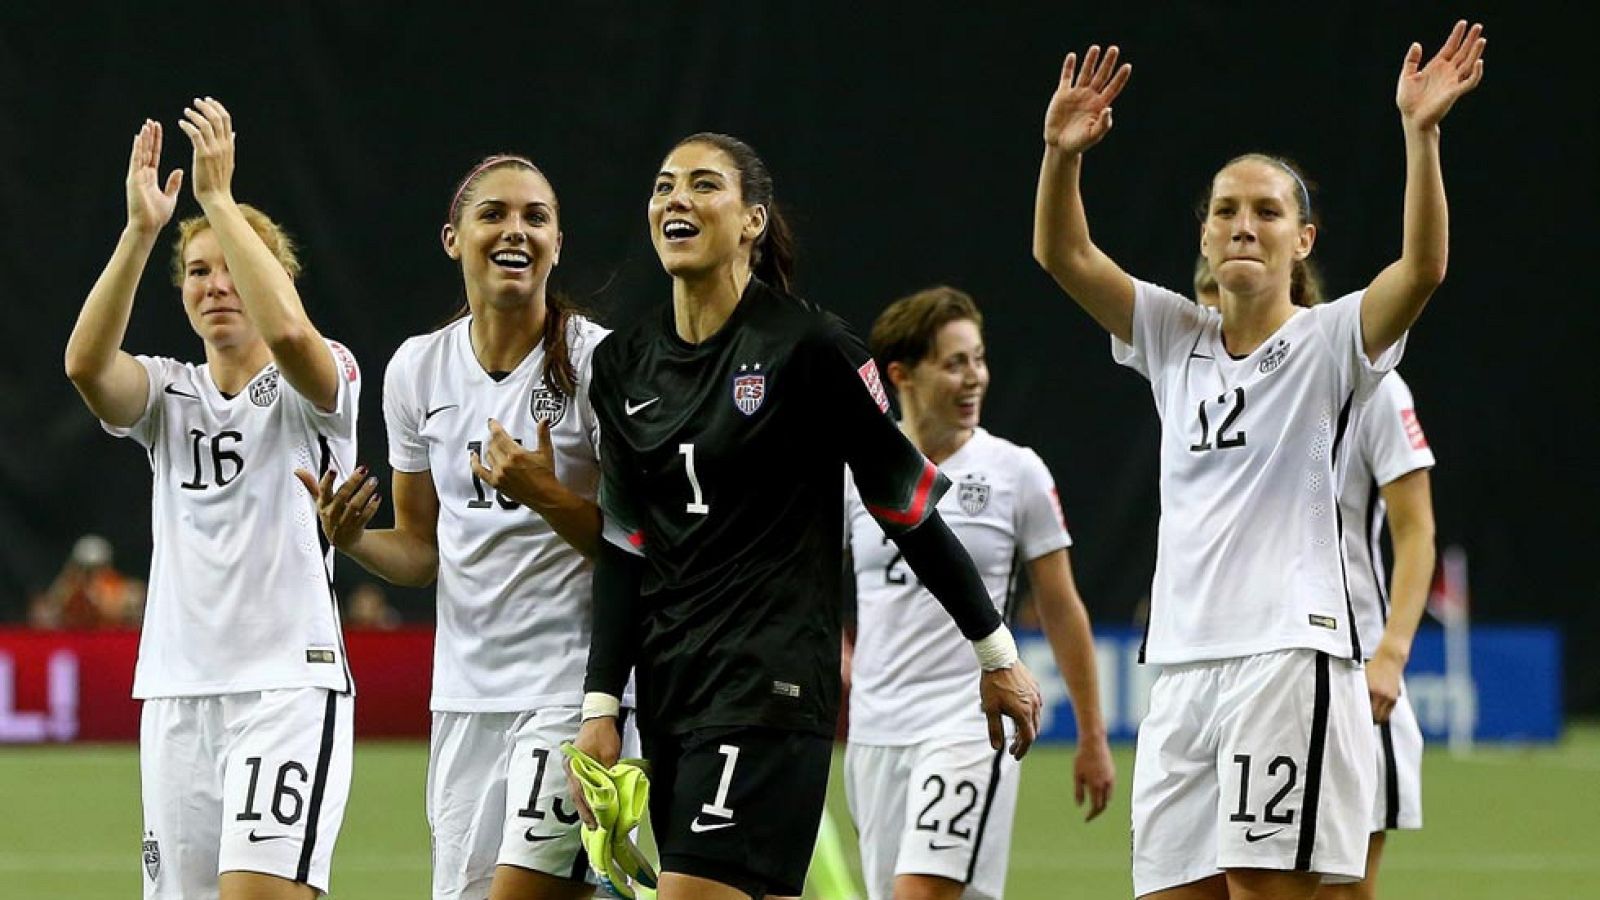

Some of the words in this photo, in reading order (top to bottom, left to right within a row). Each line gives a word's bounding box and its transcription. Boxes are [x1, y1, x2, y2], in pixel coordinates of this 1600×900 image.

[1190, 387, 1247, 452] 12
[181, 428, 244, 491] 16
[467, 440, 523, 510] 1
[679, 443, 709, 514] 1
[236, 757, 308, 825] 16
[702, 744, 740, 819] 1
[916, 774, 979, 841] 22
[1230, 754, 1299, 824] 12
